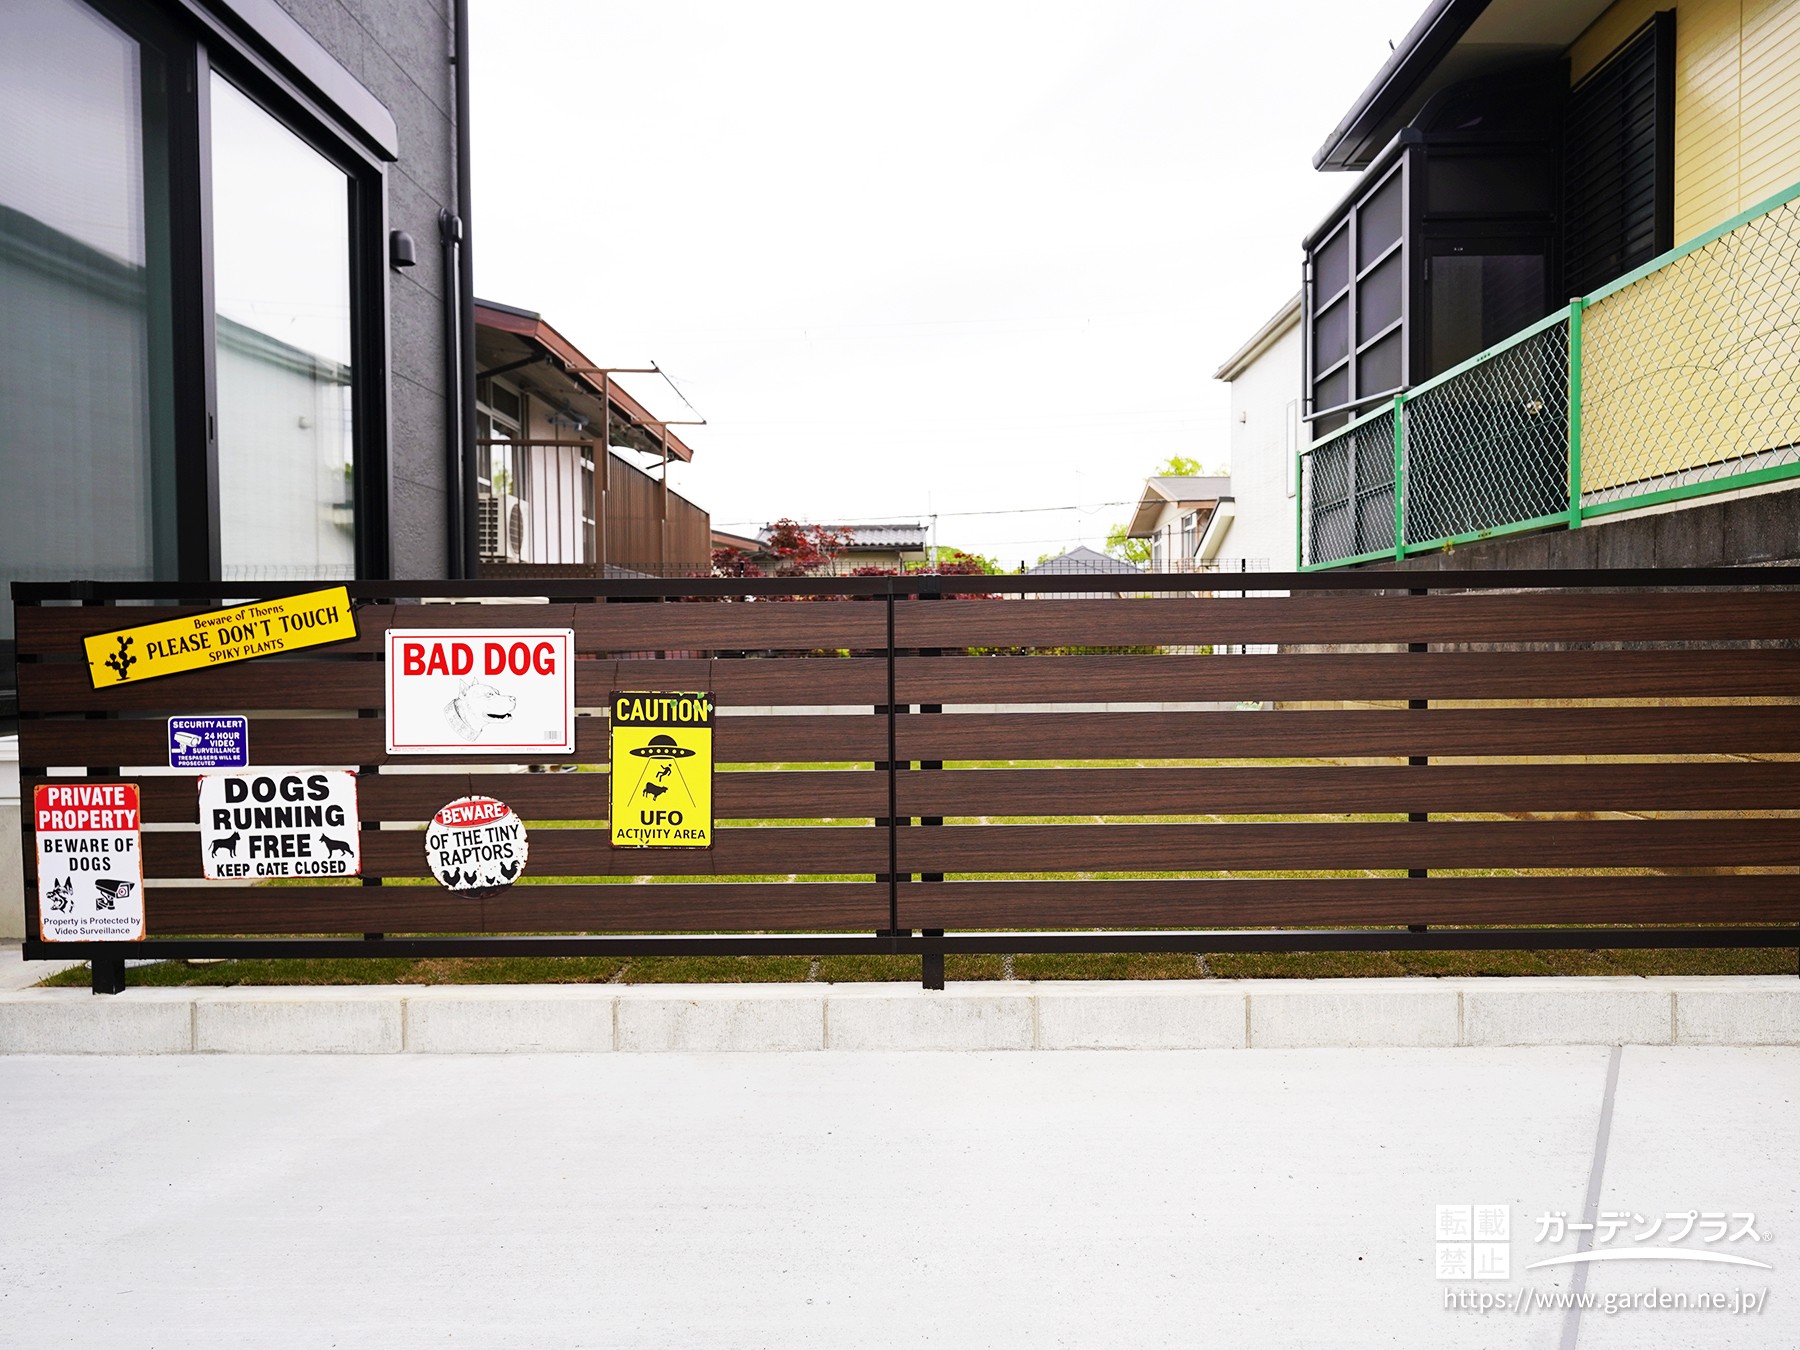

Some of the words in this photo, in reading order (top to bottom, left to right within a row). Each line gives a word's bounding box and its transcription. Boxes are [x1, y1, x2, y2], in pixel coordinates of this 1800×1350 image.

[194, 615, 233, 630] Beware
[235, 610, 246, 621] of
[248, 605, 284, 618] Thorns
[146, 632, 211, 660] PLEASE
[218, 619, 271, 645] DON'T
[279, 606, 339, 633] TOUCH
[209, 647, 240, 662] SPIKY
[244, 638, 284, 655] PLANTS
[403, 643, 474, 676] BAD
[484, 642, 555, 676] DOG
[616, 698, 708, 722] CAUTION
[216, 720, 243, 728] ALERT
[204, 732, 215, 740] 24
[48, 786, 125, 806] PRIVATE
[224, 774, 330, 803] DOGS
[39, 809, 136, 830] PROPERTY
[213, 804, 345, 830] RUNNING
[441, 803, 504, 825] BEWARE
[640, 810, 683, 826] UFO
[430, 833, 449, 850] OF
[453, 829, 482, 847] THE
[485, 824, 519, 843] TINY
[616, 828, 671, 839] ACTIVITY
[674, 829, 706, 839] AREA
[44, 838, 110, 853] BEWARE
[114, 838, 134, 852] OF
[249, 833, 312, 859] FREE
[439, 842, 514, 867] RAPTORS
[69, 857, 111, 871] DOGS
[216, 863, 250, 877] KEEP
[256, 862, 289, 876] GATE
[295, 860, 346, 874] CLOSED
[43, 917, 79, 927] Property
[80, 917, 88, 925] is
[89, 917, 129, 925] Protected
[130, 917, 141, 926] by
[54, 927, 78, 935] Video
[79, 927, 131, 935] Surveillance
